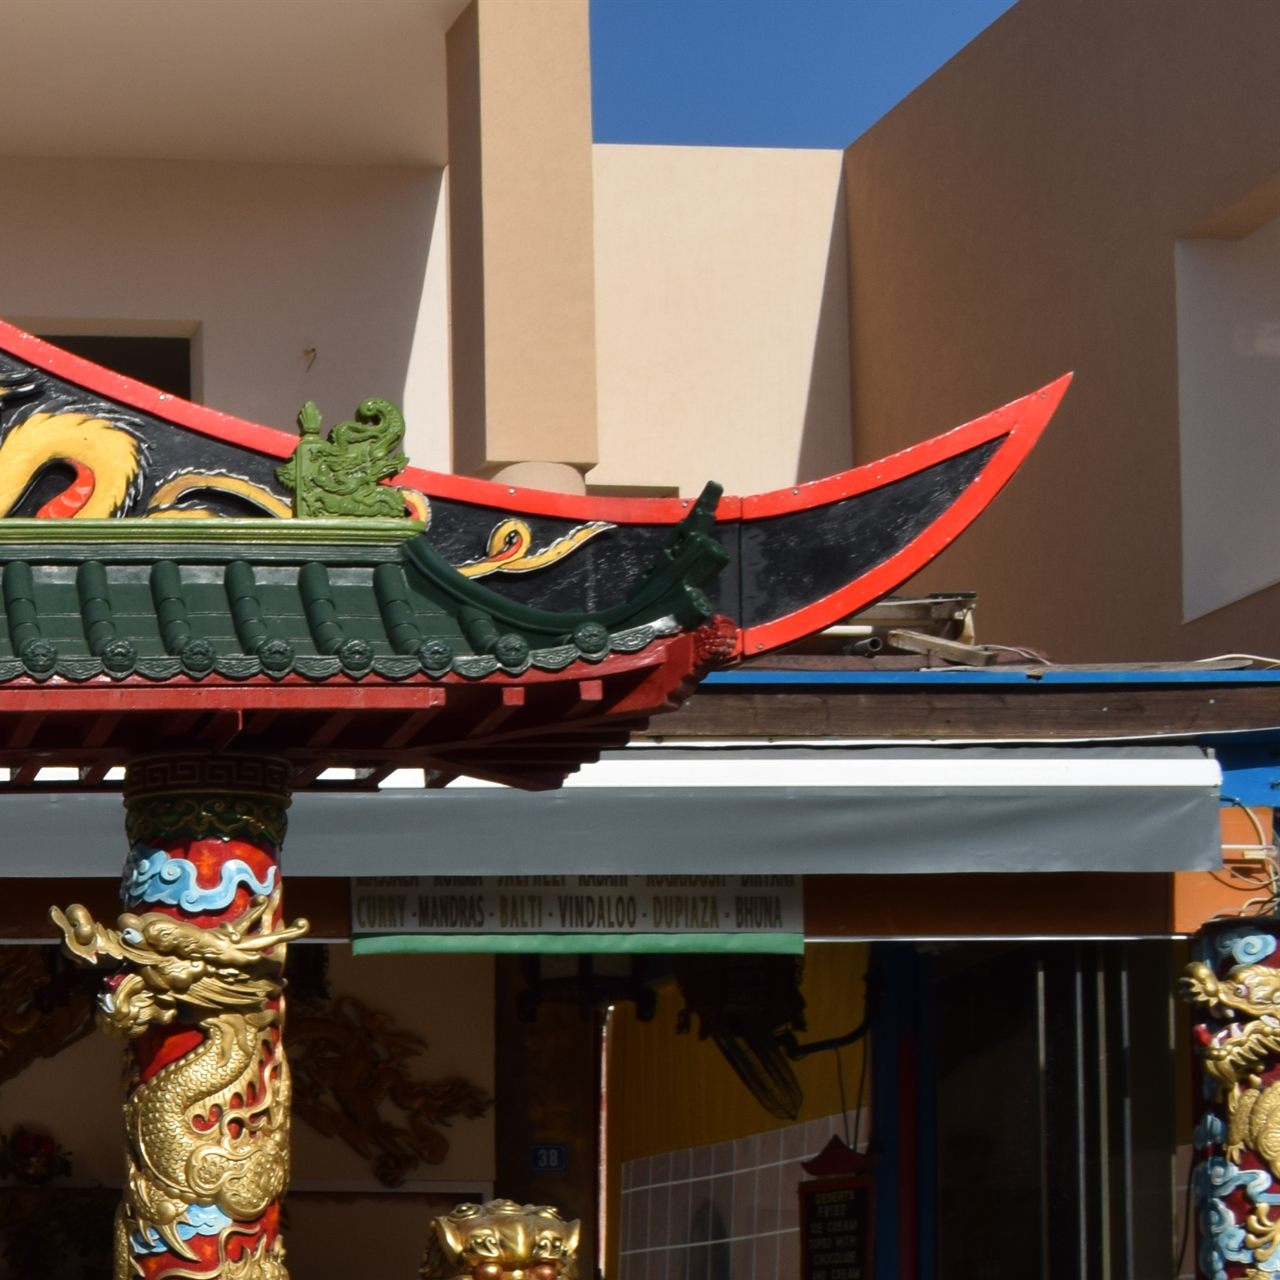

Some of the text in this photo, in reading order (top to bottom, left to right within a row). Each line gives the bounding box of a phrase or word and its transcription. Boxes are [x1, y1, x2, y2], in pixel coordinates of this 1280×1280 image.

[419, 895, 485, 928] MANDRAS
[499, 895, 539, 928] BALTI
[559, 895, 637, 929] VINDALOO
[653, 895, 718, 929] DUPIAZA
[538, 1149, 558, 1167] 38
